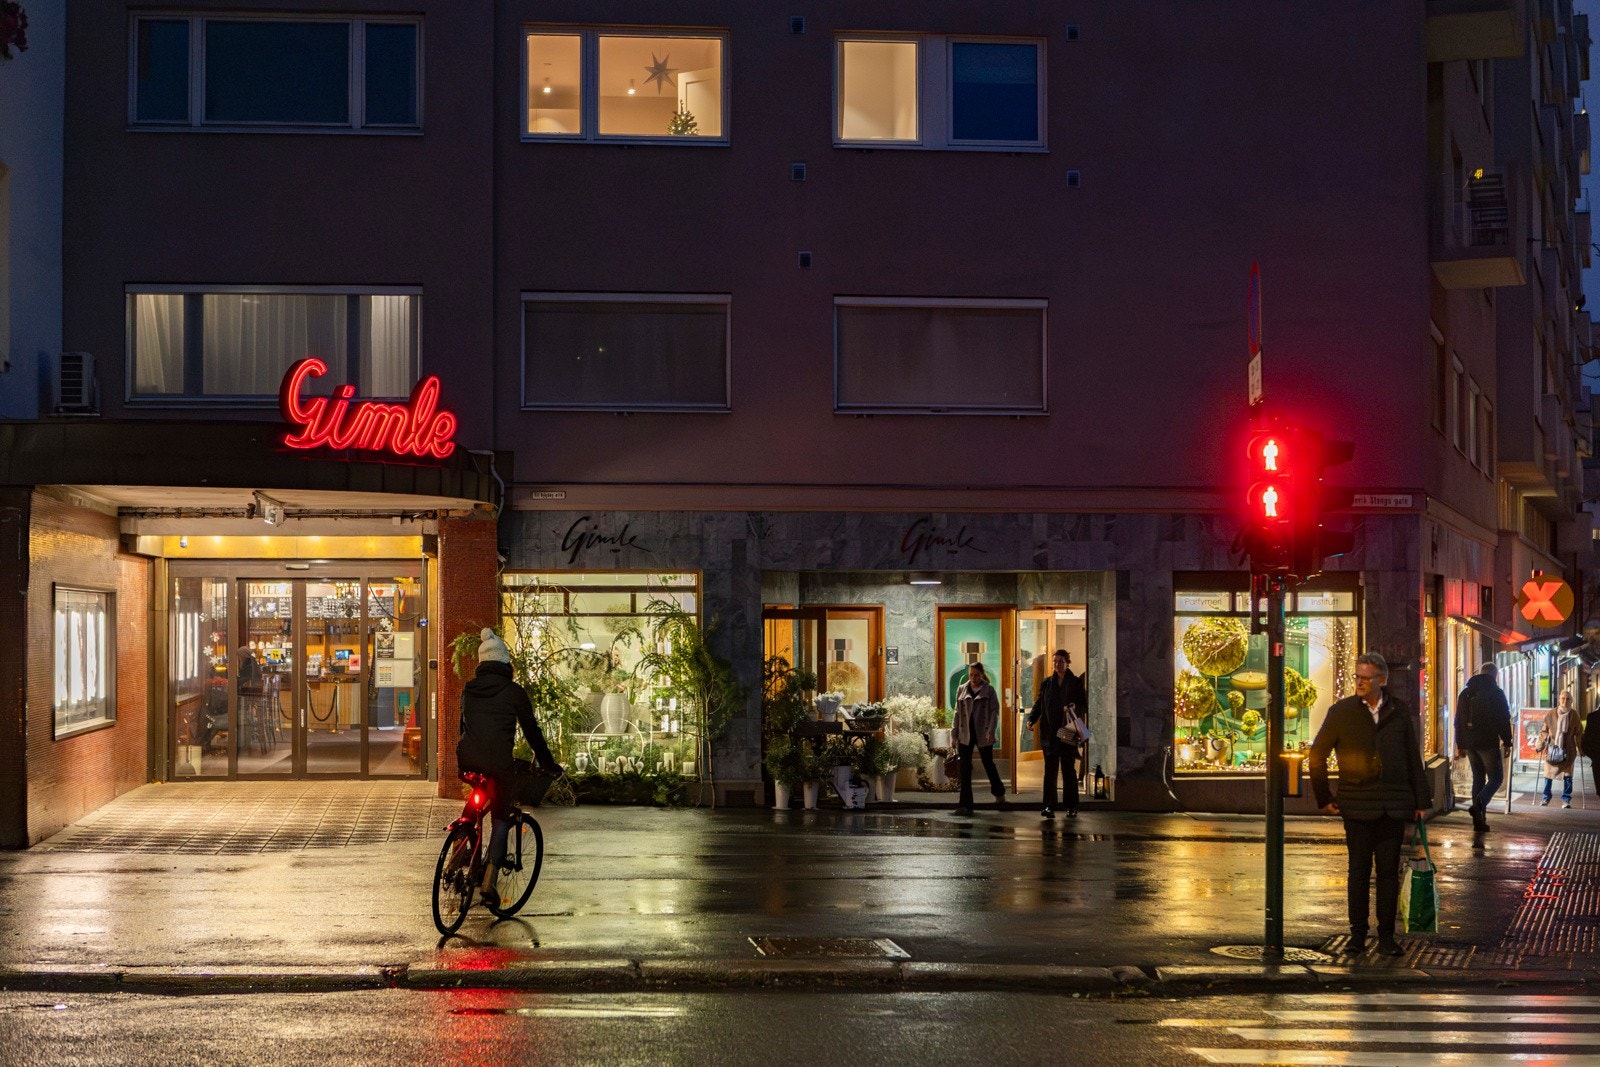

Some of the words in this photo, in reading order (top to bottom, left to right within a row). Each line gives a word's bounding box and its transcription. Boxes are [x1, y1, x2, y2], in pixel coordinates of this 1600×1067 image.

[282, 356, 458, 459] Gimle
[561, 515, 651, 565] Gimle
[900, 517, 987, 565] Gimle
